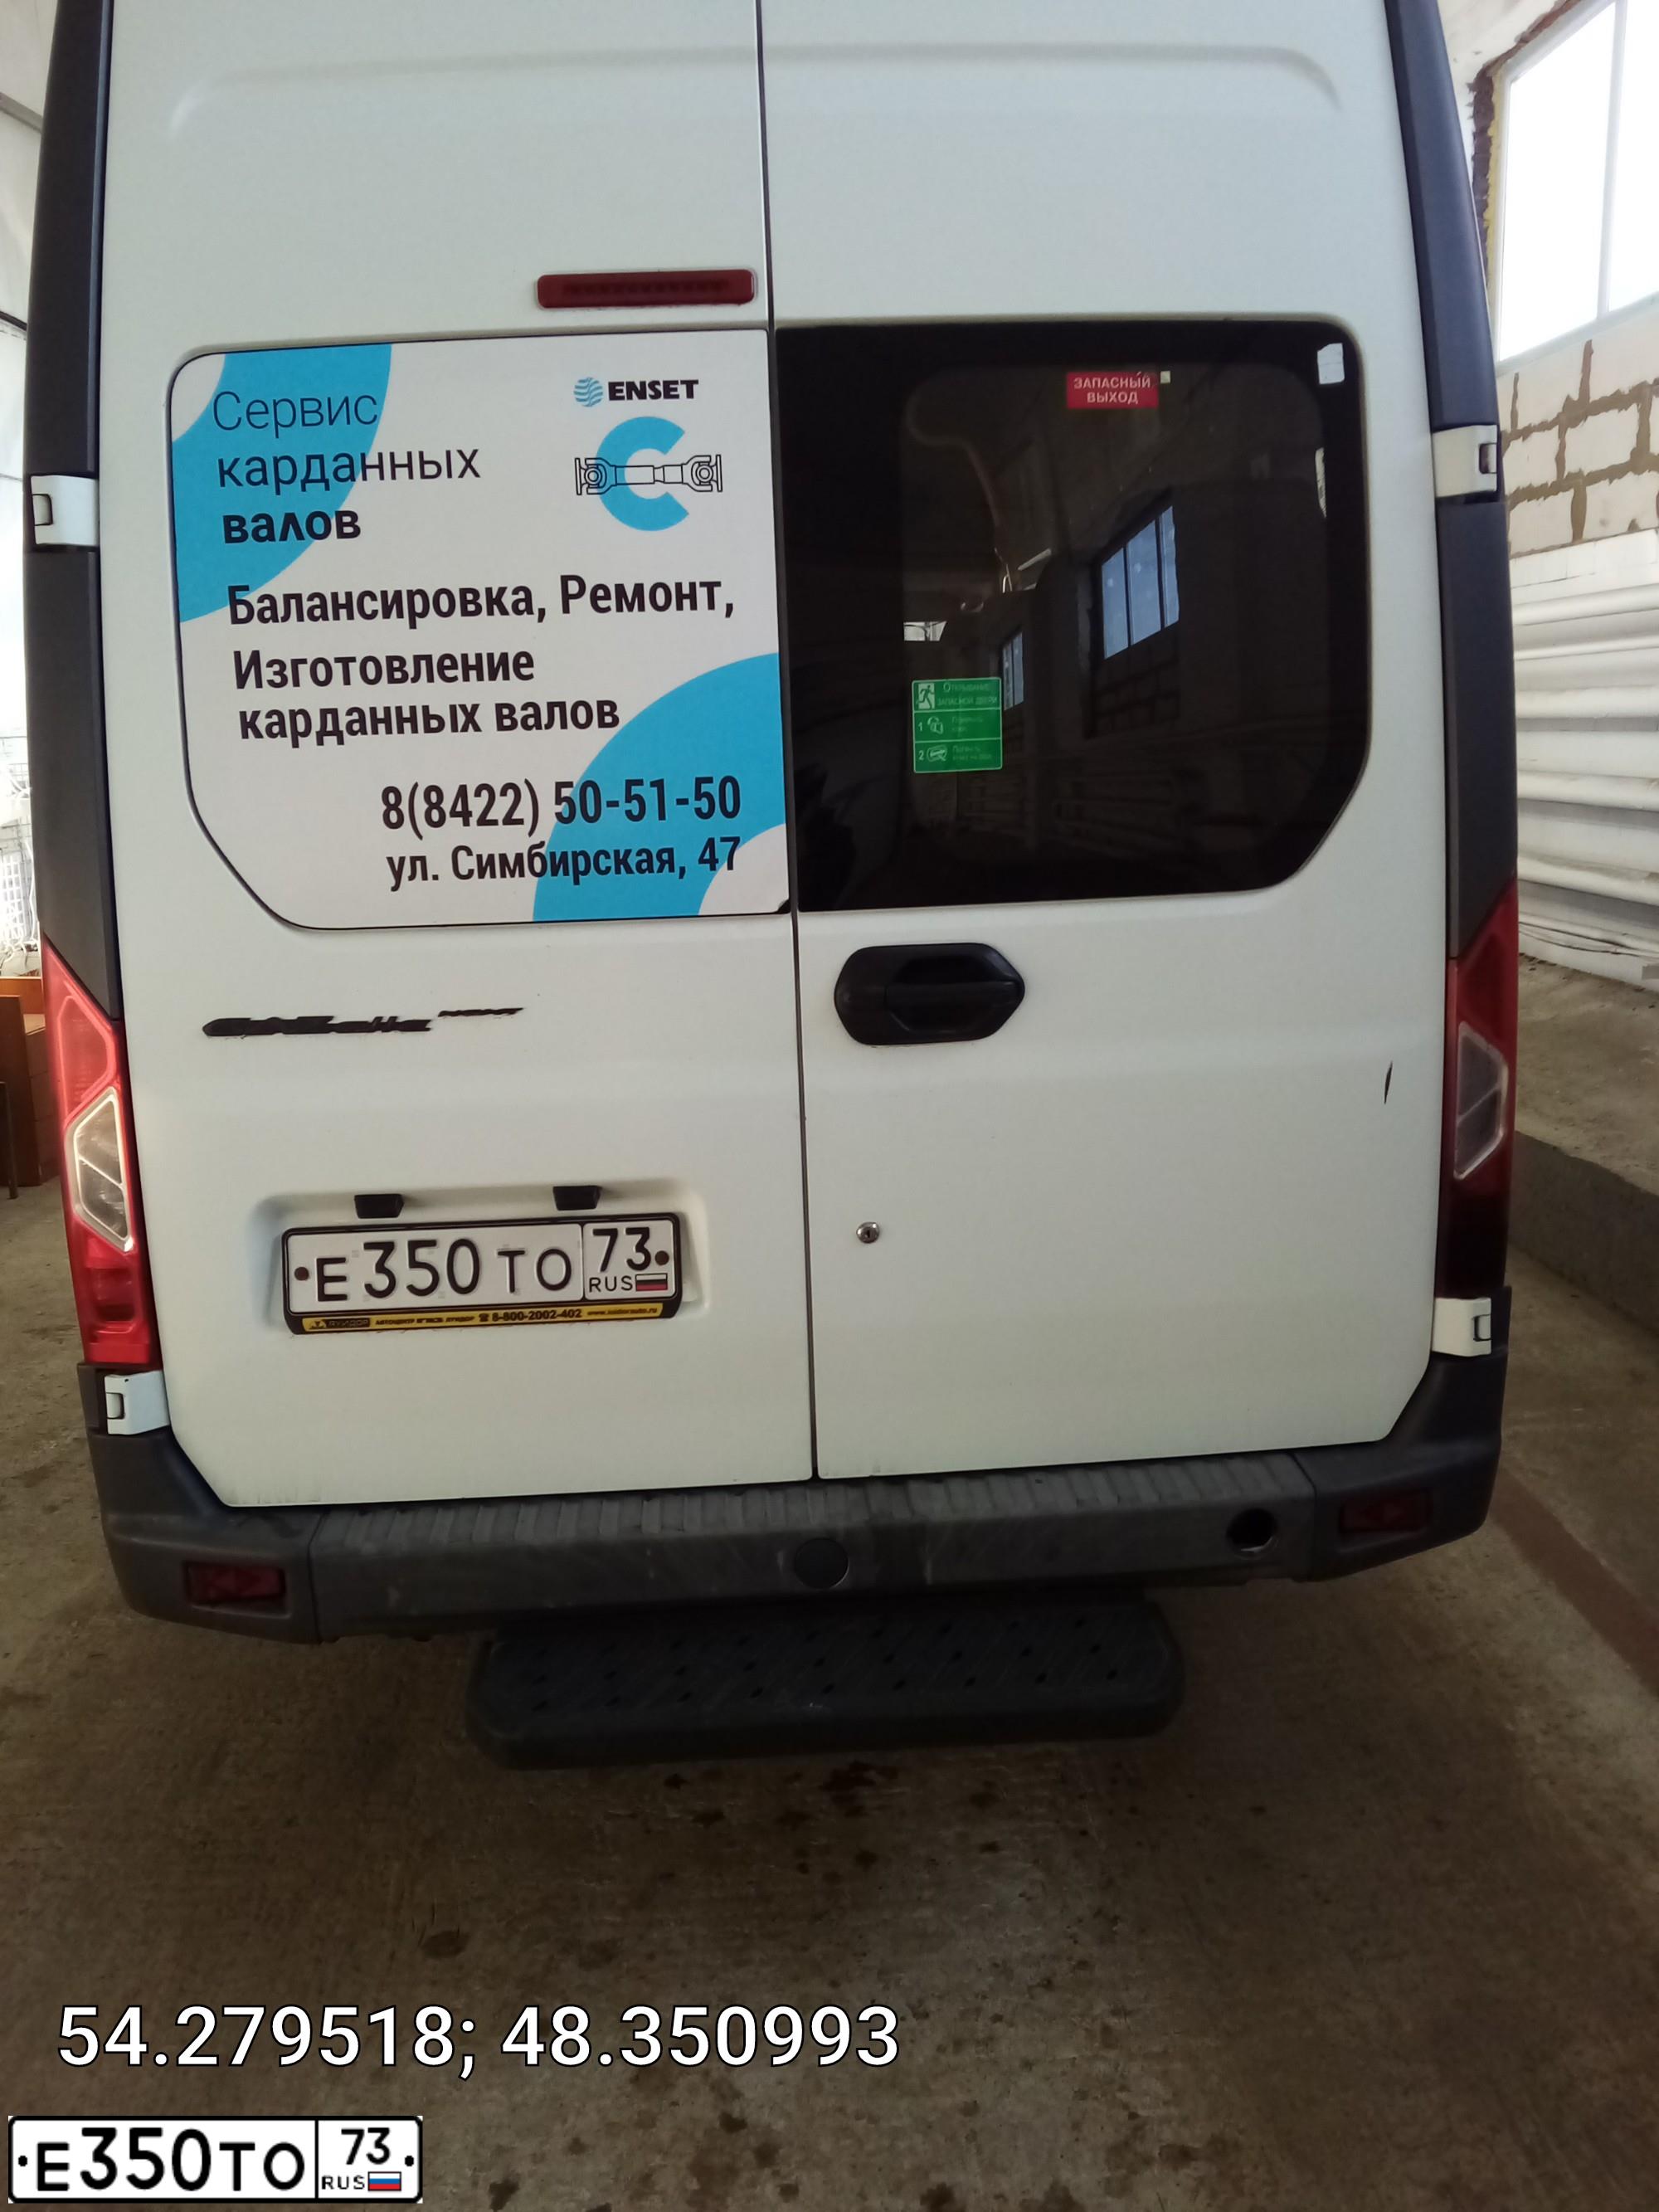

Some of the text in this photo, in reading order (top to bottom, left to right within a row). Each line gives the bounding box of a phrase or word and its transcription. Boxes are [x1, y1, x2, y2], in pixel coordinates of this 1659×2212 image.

[608, 379, 699, 402] ENSET
[1073, 373, 1151, 389] ЗАПАСНЫЙ
[1087, 391, 1139, 405] ВЫХОД
[212, 390, 378, 440] Сервис
[217, 449, 480, 496] карданных
[221, 509, 362, 544] валов
[227, 574, 733, 630] Балансировка, Ремонт,
[233, 650, 534, 689] Изготовление
[239, 699, 620, 749] карданных валов
[381, 775, 741, 840] 8(8422) 50-51-50
[386, 836, 741, 893] ул. Симбирская, 47
[592, 1226, 652, 1272] 73
[588, 1275, 634, 1294] RUS
[492, 1308, 581, 1323] 8-800-2002-402
